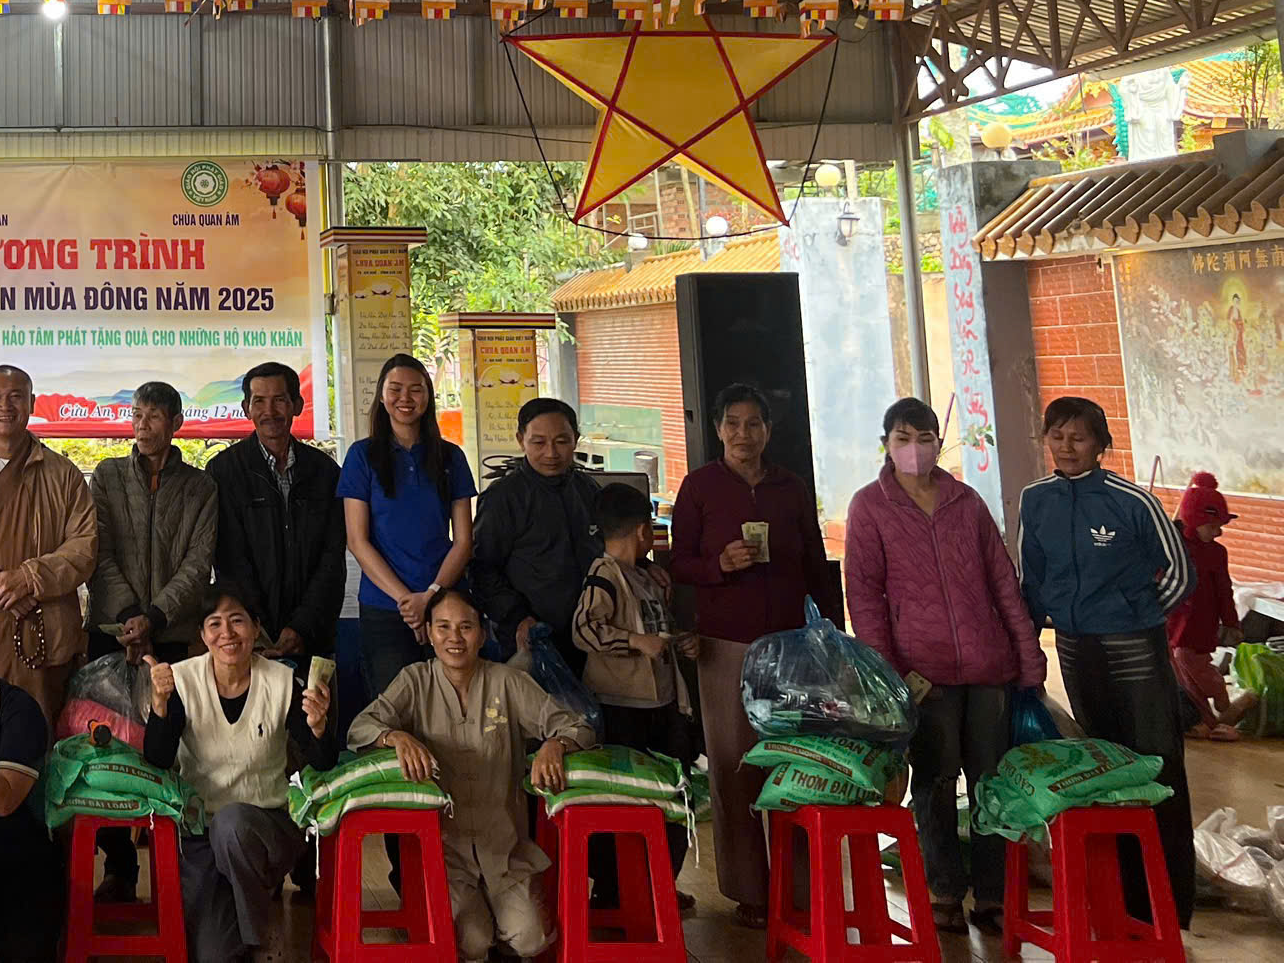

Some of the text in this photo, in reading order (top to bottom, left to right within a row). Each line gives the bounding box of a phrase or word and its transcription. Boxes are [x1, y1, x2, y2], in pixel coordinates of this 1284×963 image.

[172, 211, 239, 227] CHÙA QUAN ÂM
[90, 232, 205, 270] TRÌNH
[24, 281, 76, 310] MÙA
[84, 281, 148, 311] ĐÔNG
[156, 281, 210, 310] NĂM
[218, 287, 274, 311] 2025
[2, 325, 25, 346] HẢO
[29, 326, 54, 346] TÂM
[57, 326, 87, 346] PHÁT
[90, 326, 121, 349] TẶNG
[125, 327, 149, 347] QUÀ
[152, 329, 175, 346] CHO
[179, 326, 220, 346] NHỮNG
[223, 326, 239, 349] HỘ
[243, 327, 266, 347] KHÓ
[270, 327, 303, 347] KHĂN
[60, 404, 87, 418] Cửu
[91, 405, 115, 420] An,
[214, 404, 227, 418] 12
